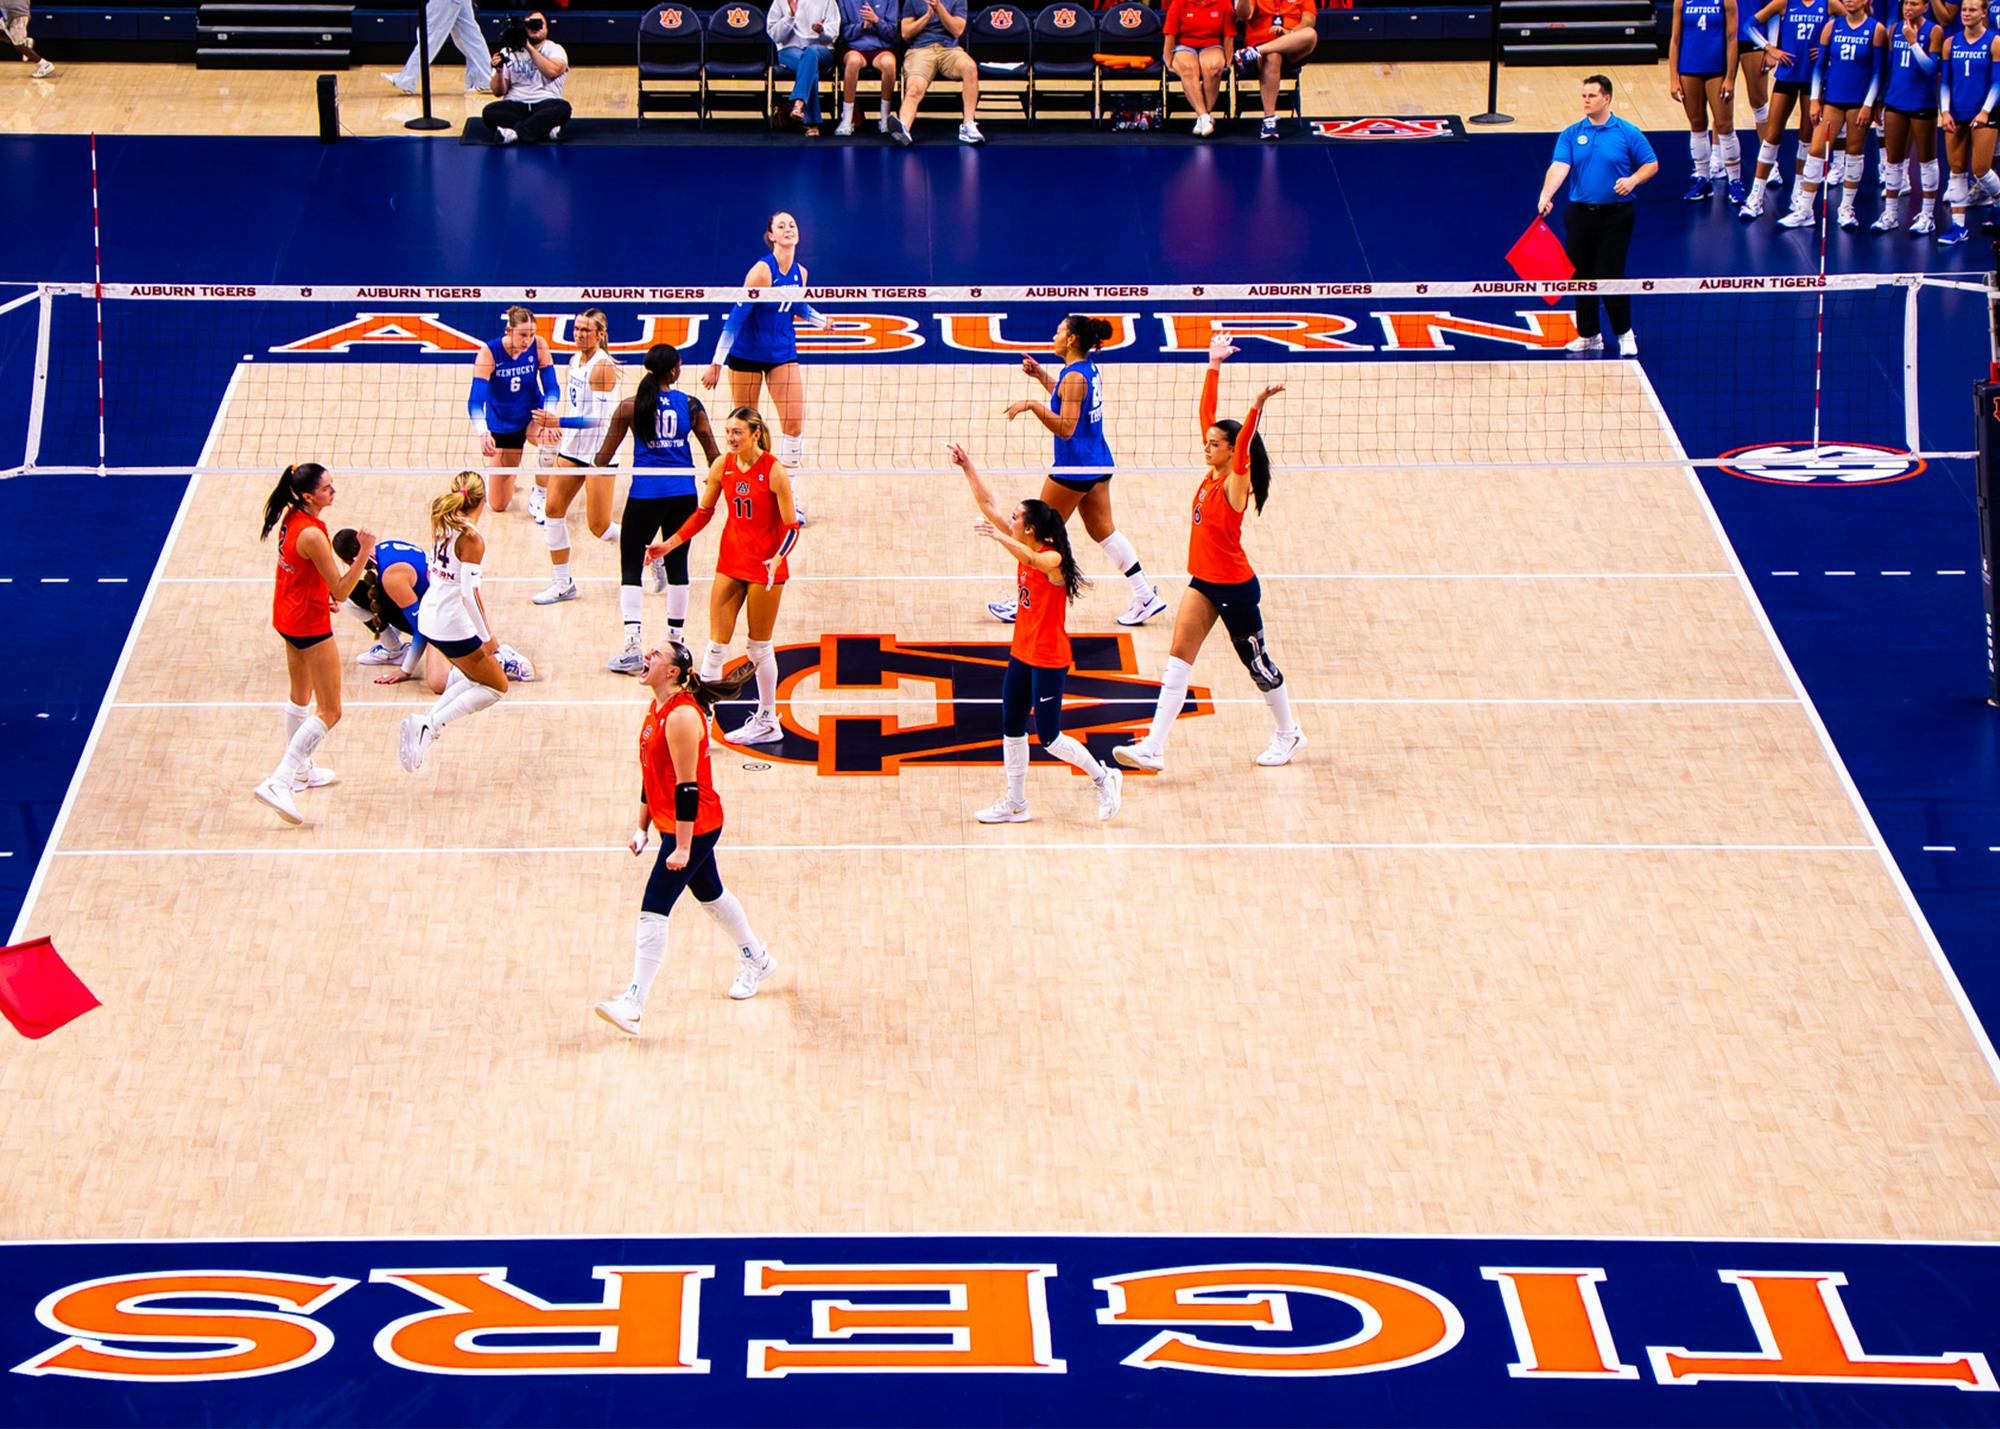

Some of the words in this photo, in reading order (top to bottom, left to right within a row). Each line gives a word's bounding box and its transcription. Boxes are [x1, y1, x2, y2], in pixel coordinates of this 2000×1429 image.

[1686, 6, 1720, 14] KENTUCKY
[1697, 15, 1707, 31] 4
[1790, 14, 1824, 23] KENTUCKY
[1797, 24, 1815, 40] 27
[1834, 35, 1869, 44] KENTUCKY
[1840, 44, 1856, 60] 21
[1952, 51, 1986, 59] KENTUCKY
[1900, 50, 1911, 67] 11
[1964, 59, 1971, 77] 1
[1472, 282, 1537, 293] AUBURN
[1541, 281, 1598, 292] TIGERS
[1699, 278, 1763, 290] AUBURN
[1769, 276, 1827, 288] TIGERS
[131, 286, 195, 297] AUBURN
[200, 286, 256, 297] TIGERS
[357, 287, 420, 299] AUBURN
[425, 287, 481, 299] TIGERS
[581, 287, 645, 299] AUBURN
[649, 287, 705, 298] TIGERS
[803, 288, 867, 299] AUBURN
[872, 288, 926, 298] TIGERS
[1026, 287, 1089, 297] AUBURN
[1093, 286, 1149, 297] TIGERS
[1248, 285, 1312, 297] AUBURN
[1317, 284, 1373, 296] TIGERS
[269, 311, 1581, 355] AUBURN
[496, 365, 534, 377] KENTUCKY
[510, 377, 521, 392] 6
[734, 497, 751, 518] 11
[8, 1262, 2000, 1392] TIGERS
